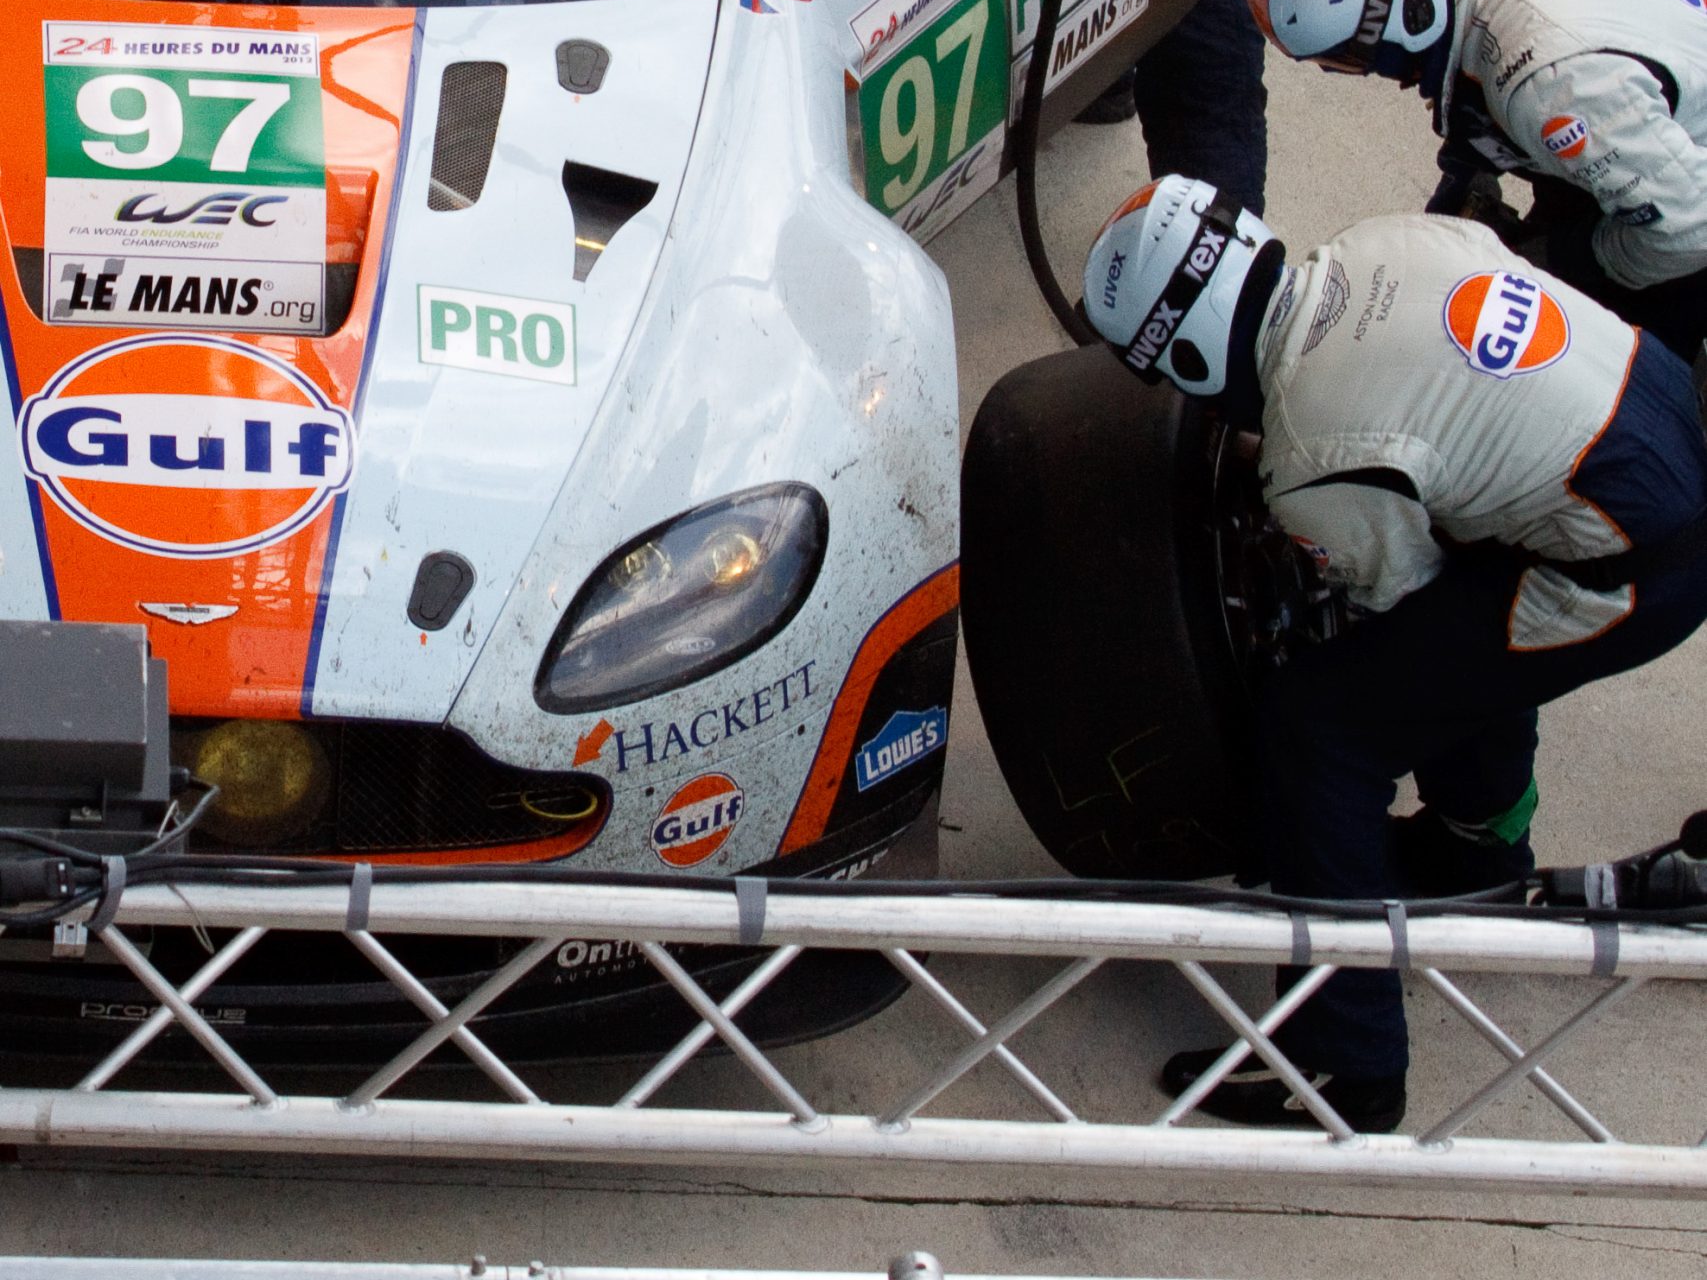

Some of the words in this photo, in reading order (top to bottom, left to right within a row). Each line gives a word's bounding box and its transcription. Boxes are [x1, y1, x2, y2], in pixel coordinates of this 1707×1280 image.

[53, 37, 118, 56] 24
[123, 42, 203, 56] HEURES
[211, 42, 240, 56] DU
[249, 42, 311, 56] MANS
[76, 74, 291, 173] 97
[1544, 122, 1587, 154] Gulf
[69, 226, 90, 236] FIA
[94, 228, 138, 238] WORLD
[140, 229, 224, 240] ENDURANCE
[114, 192, 290, 228] WEC
[121, 238, 219, 250] CHAMPIONSHIP
[69, 272, 117, 311] LE
[1104, 250, 1126, 309] uvex
[1353, 300, 1375, 341] ASTON
[1367, 264, 1386, 304] MARTIN
[1376, 280, 1399, 322] RACING
[430, 299, 565, 368] PRO
[1125, 300, 1184, 370] uvex
[1477, 274, 1537, 370] Gulf
[36, 407, 339, 479] Gulf
[613, 659, 817, 774] HACKETT
[865, 720, 938, 781] LOWE'S
[653, 796, 742, 846] Gulf
